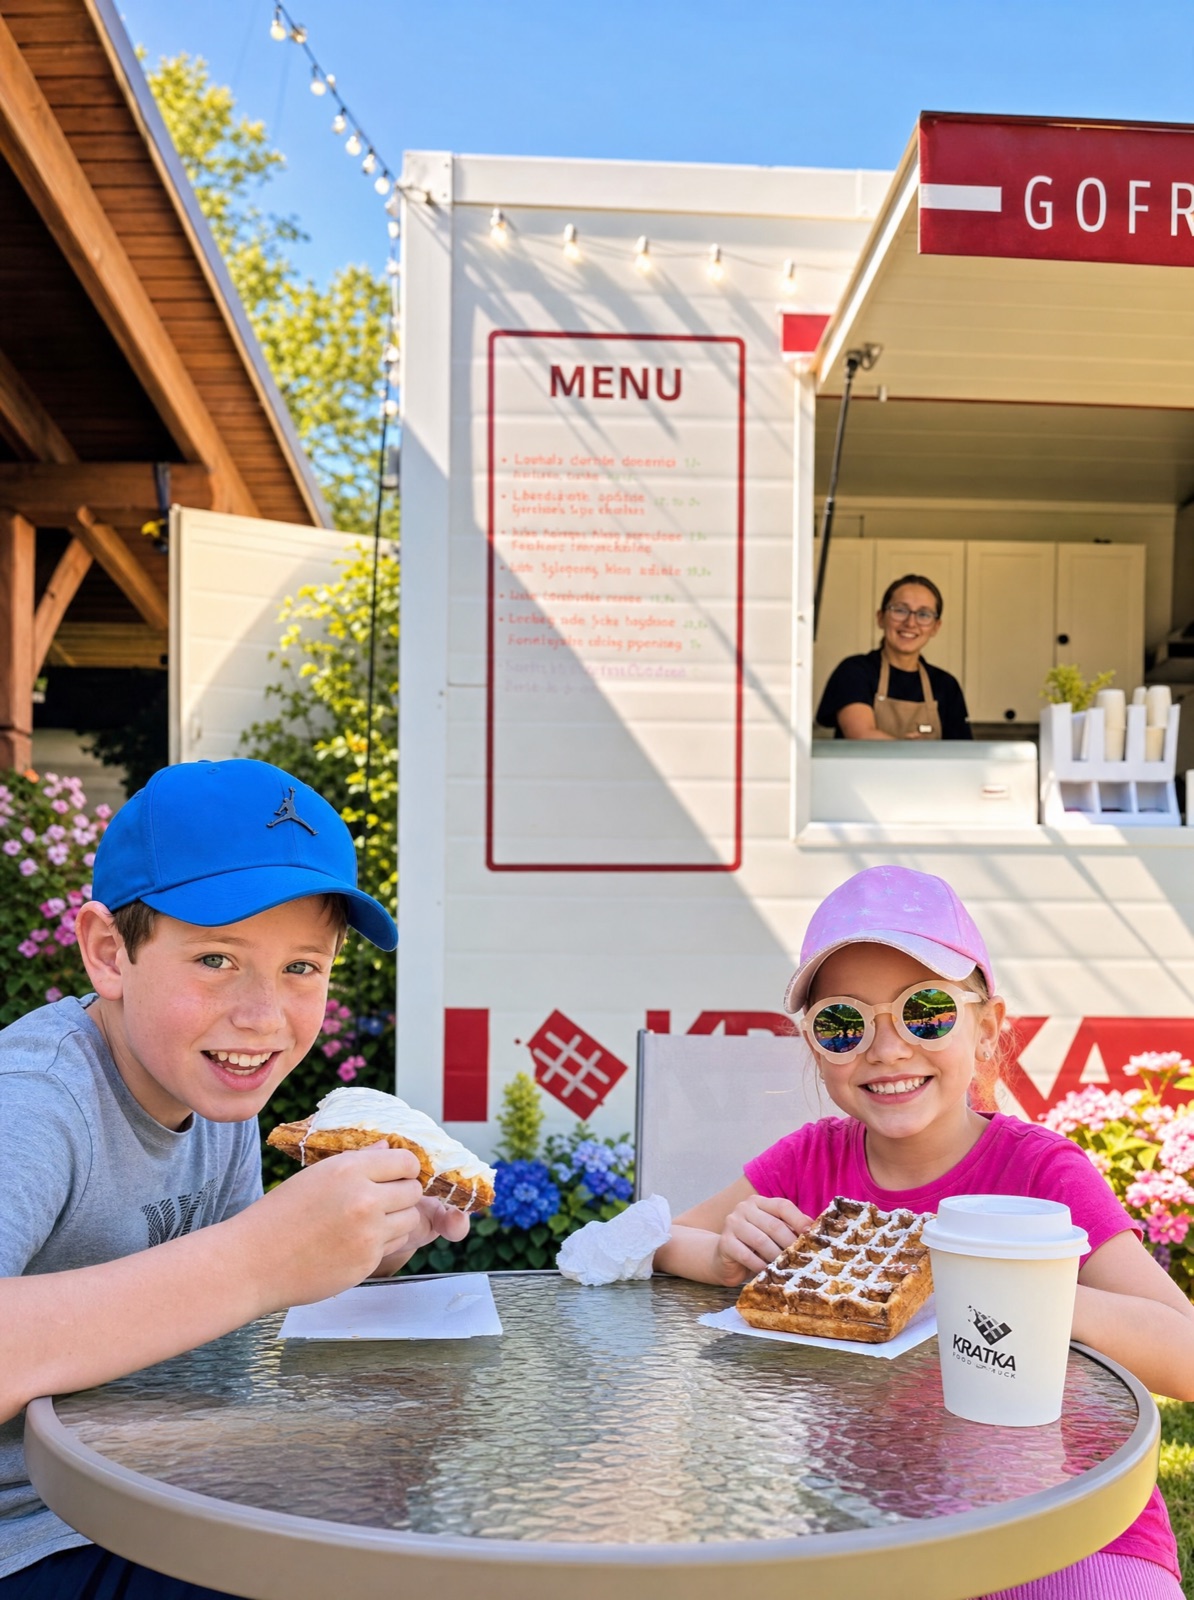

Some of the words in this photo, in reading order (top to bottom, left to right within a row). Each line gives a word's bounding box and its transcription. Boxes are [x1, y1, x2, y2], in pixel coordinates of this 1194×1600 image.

[1024, 175, 1194, 237] GOFR
[550, 364, 681, 402] MENU
[953, 1334, 1016, 1371] KRATKA
